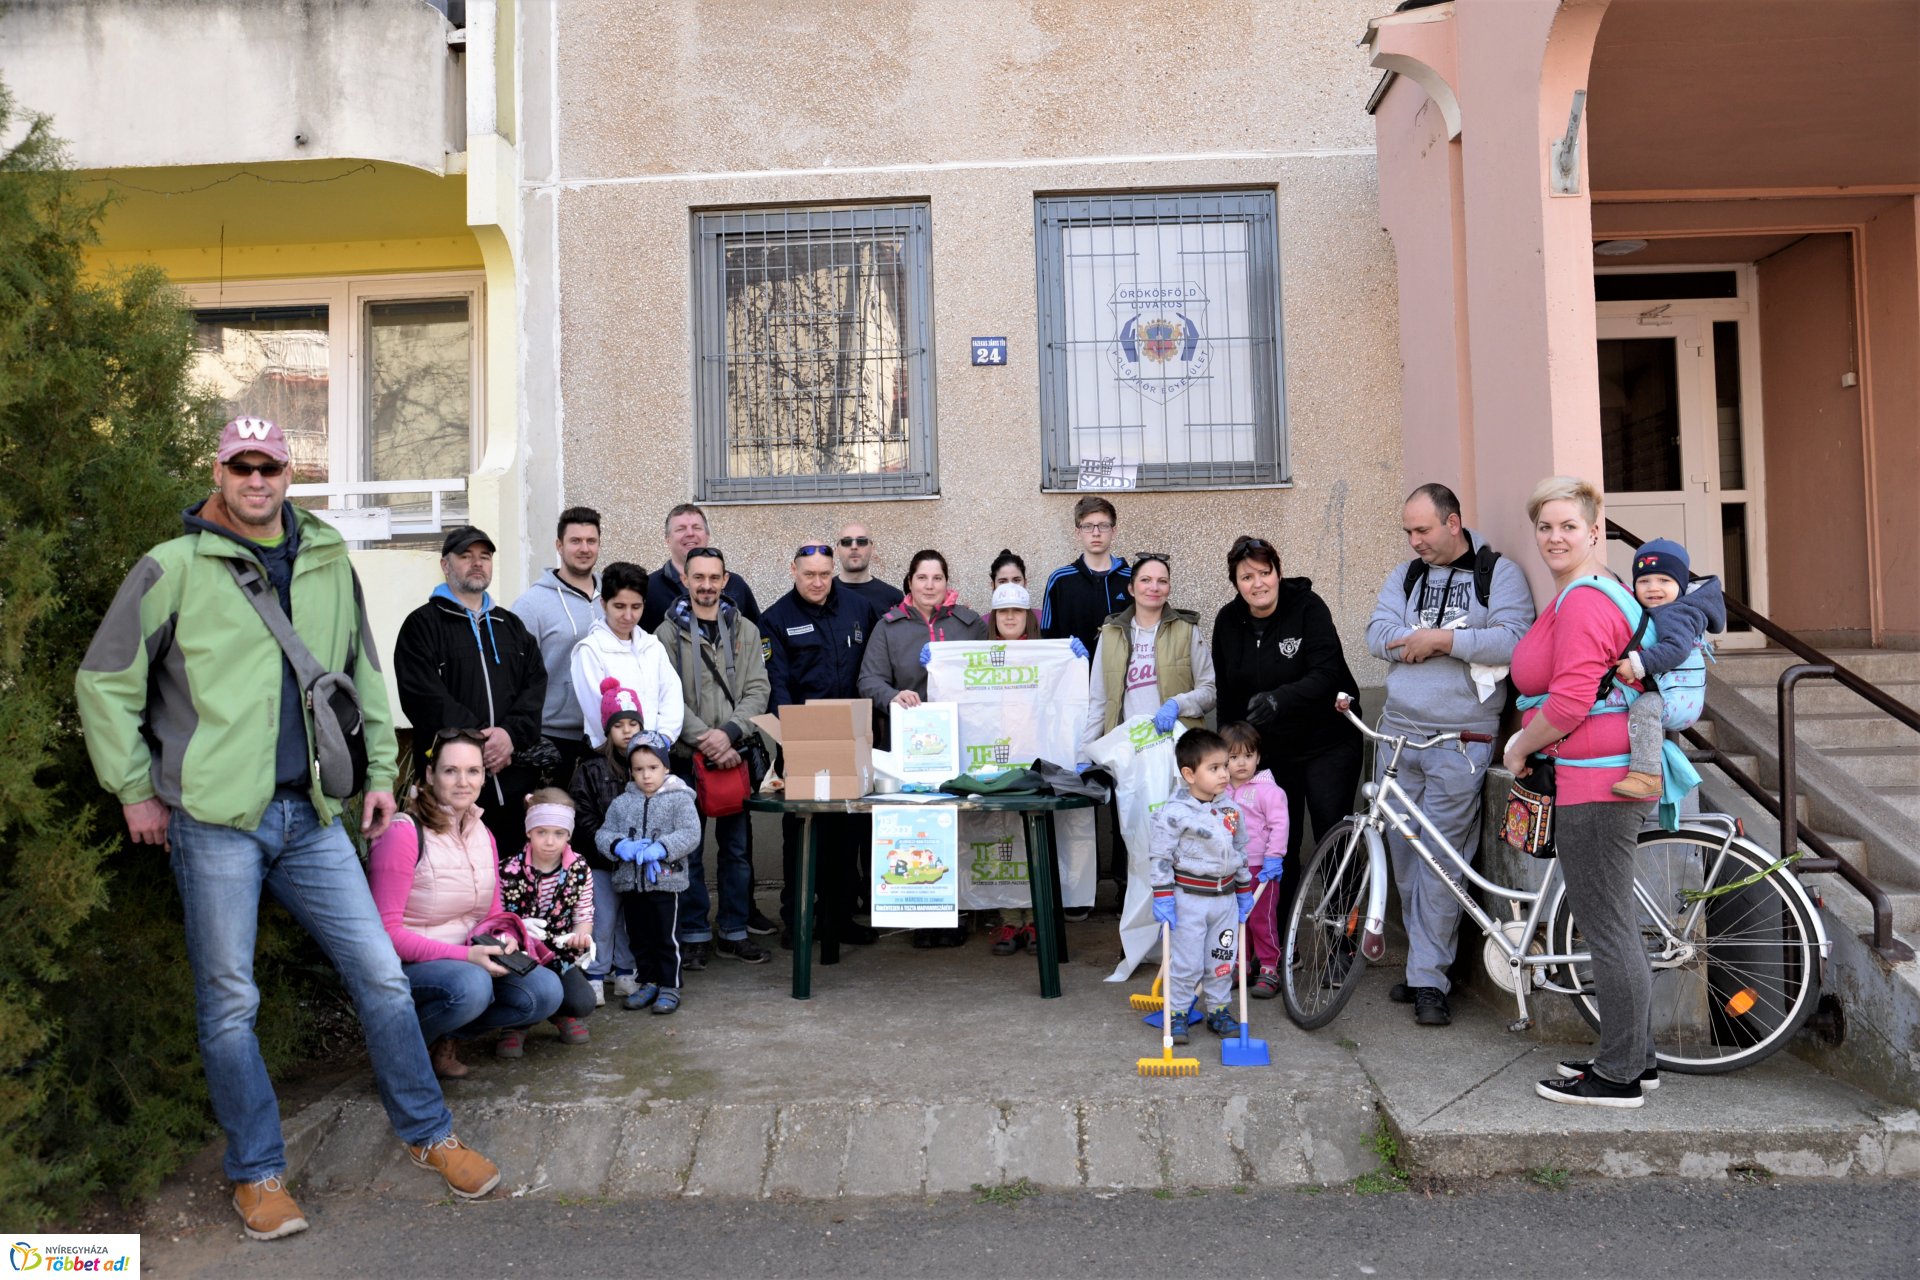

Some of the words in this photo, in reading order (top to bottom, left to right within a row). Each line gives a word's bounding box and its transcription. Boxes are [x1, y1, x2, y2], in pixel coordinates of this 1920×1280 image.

[977, 348, 1001, 363] 24
[1161, 350, 1208, 394] EGYEÜLET
[235, 418, 272, 441] W
[962, 652, 989, 669] TE
[964, 666, 1039, 686] SZEDD!
[966, 745, 992, 764] TE
[971, 862, 1030, 881] SZED
